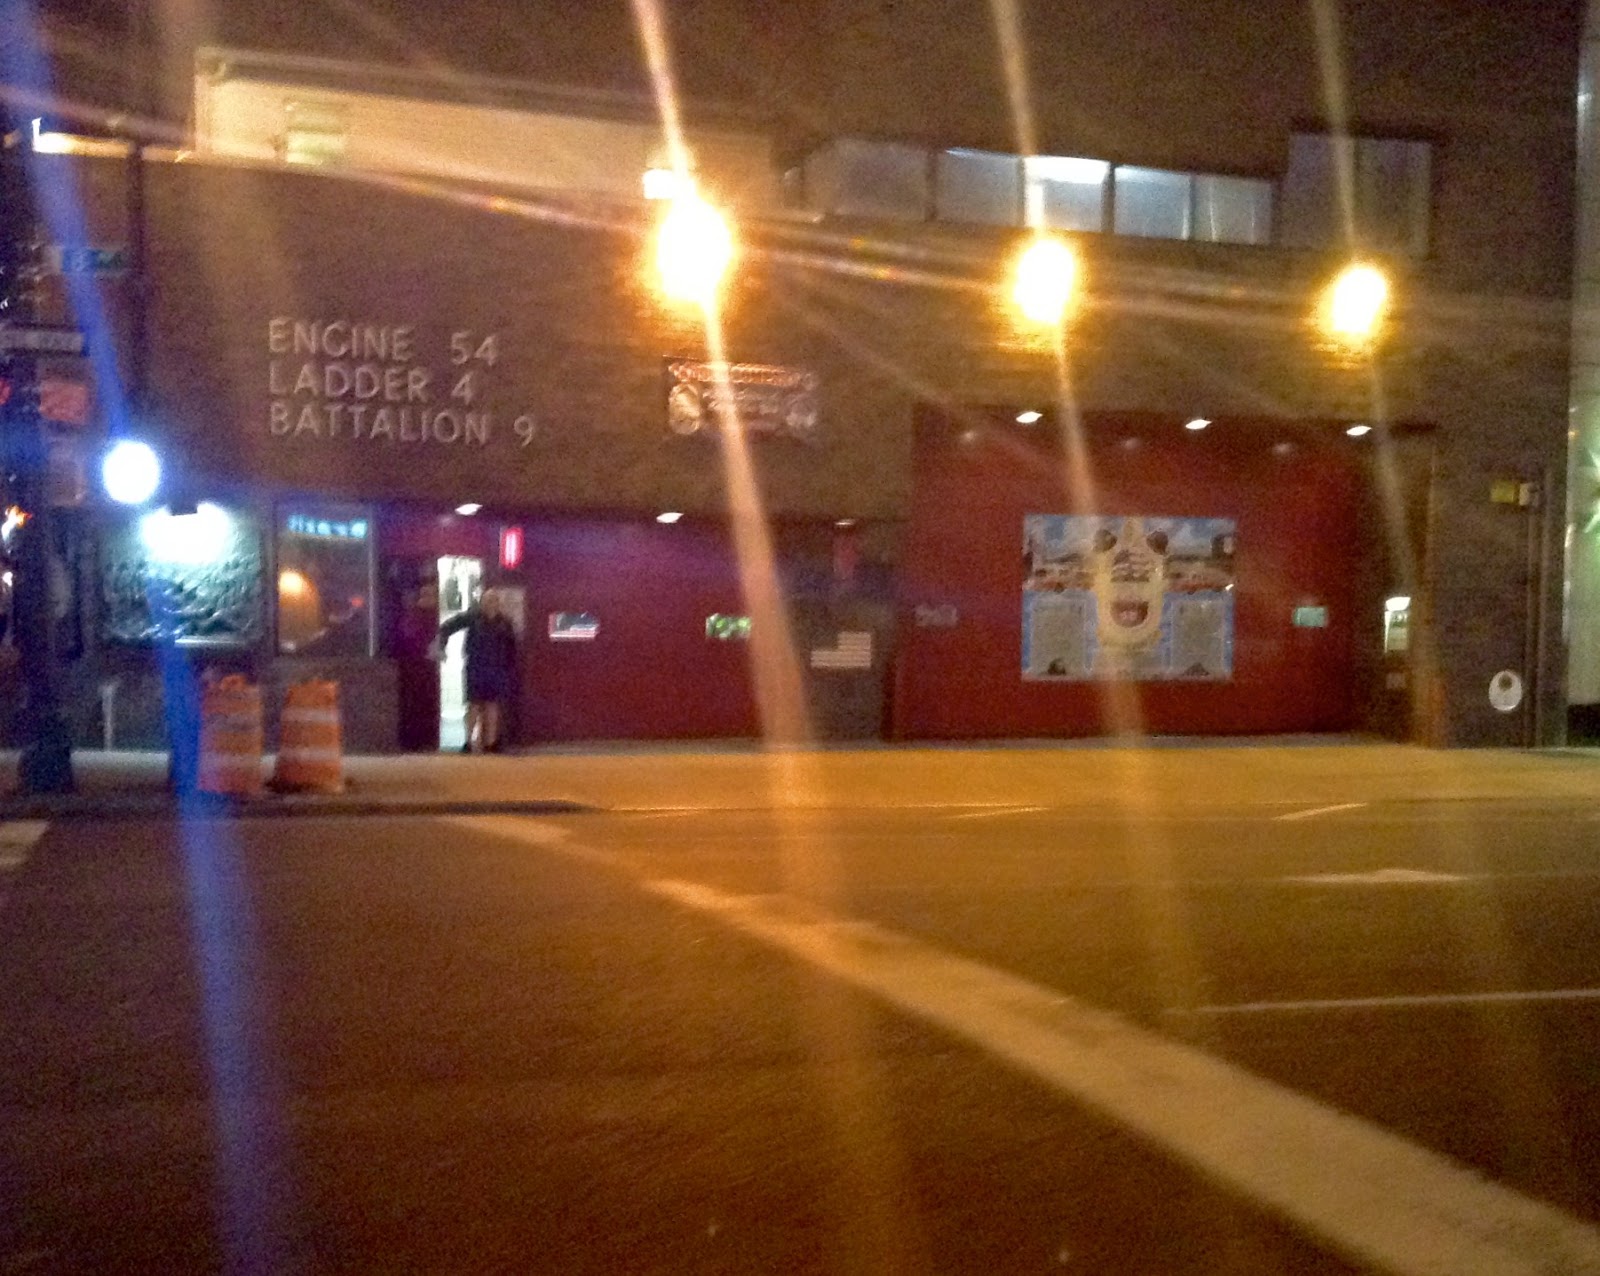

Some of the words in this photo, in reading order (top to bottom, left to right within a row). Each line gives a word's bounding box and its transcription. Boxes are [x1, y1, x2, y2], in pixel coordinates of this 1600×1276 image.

[269, 318, 413, 361] ENGINE
[451, 331, 497, 366] 54
[269, 361, 429, 402] LADDER
[452, 372, 474, 404] 4
[270, 402, 491, 445] BATTALION
[514, 415, 535, 446] 9
